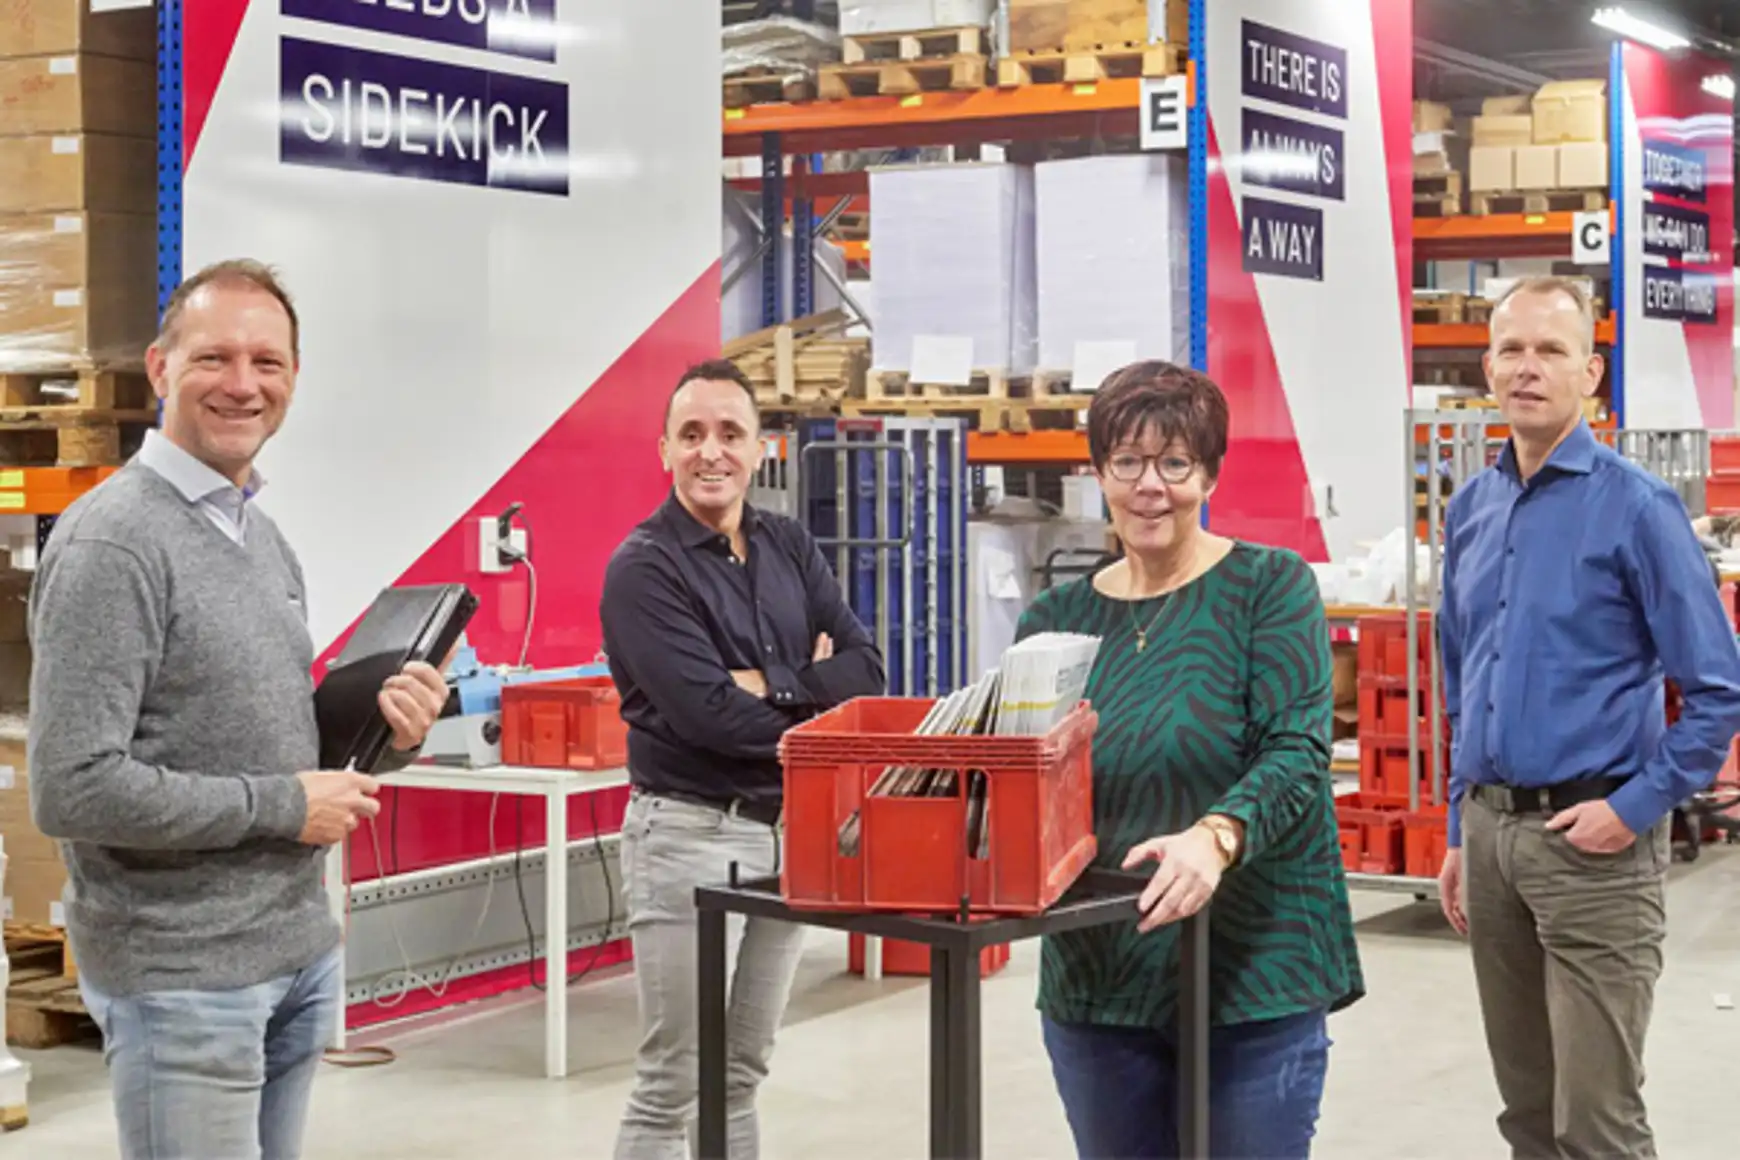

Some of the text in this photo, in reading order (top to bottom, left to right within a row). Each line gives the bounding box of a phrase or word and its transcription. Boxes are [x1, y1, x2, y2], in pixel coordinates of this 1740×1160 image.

[1247, 40, 1341, 102] THERE IS
[302, 73, 549, 166] SIDEKICK
[1150, 91, 1178, 132] E
[1248, 217, 1316, 265] A WAY
[1580, 221, 1603, 251] C
